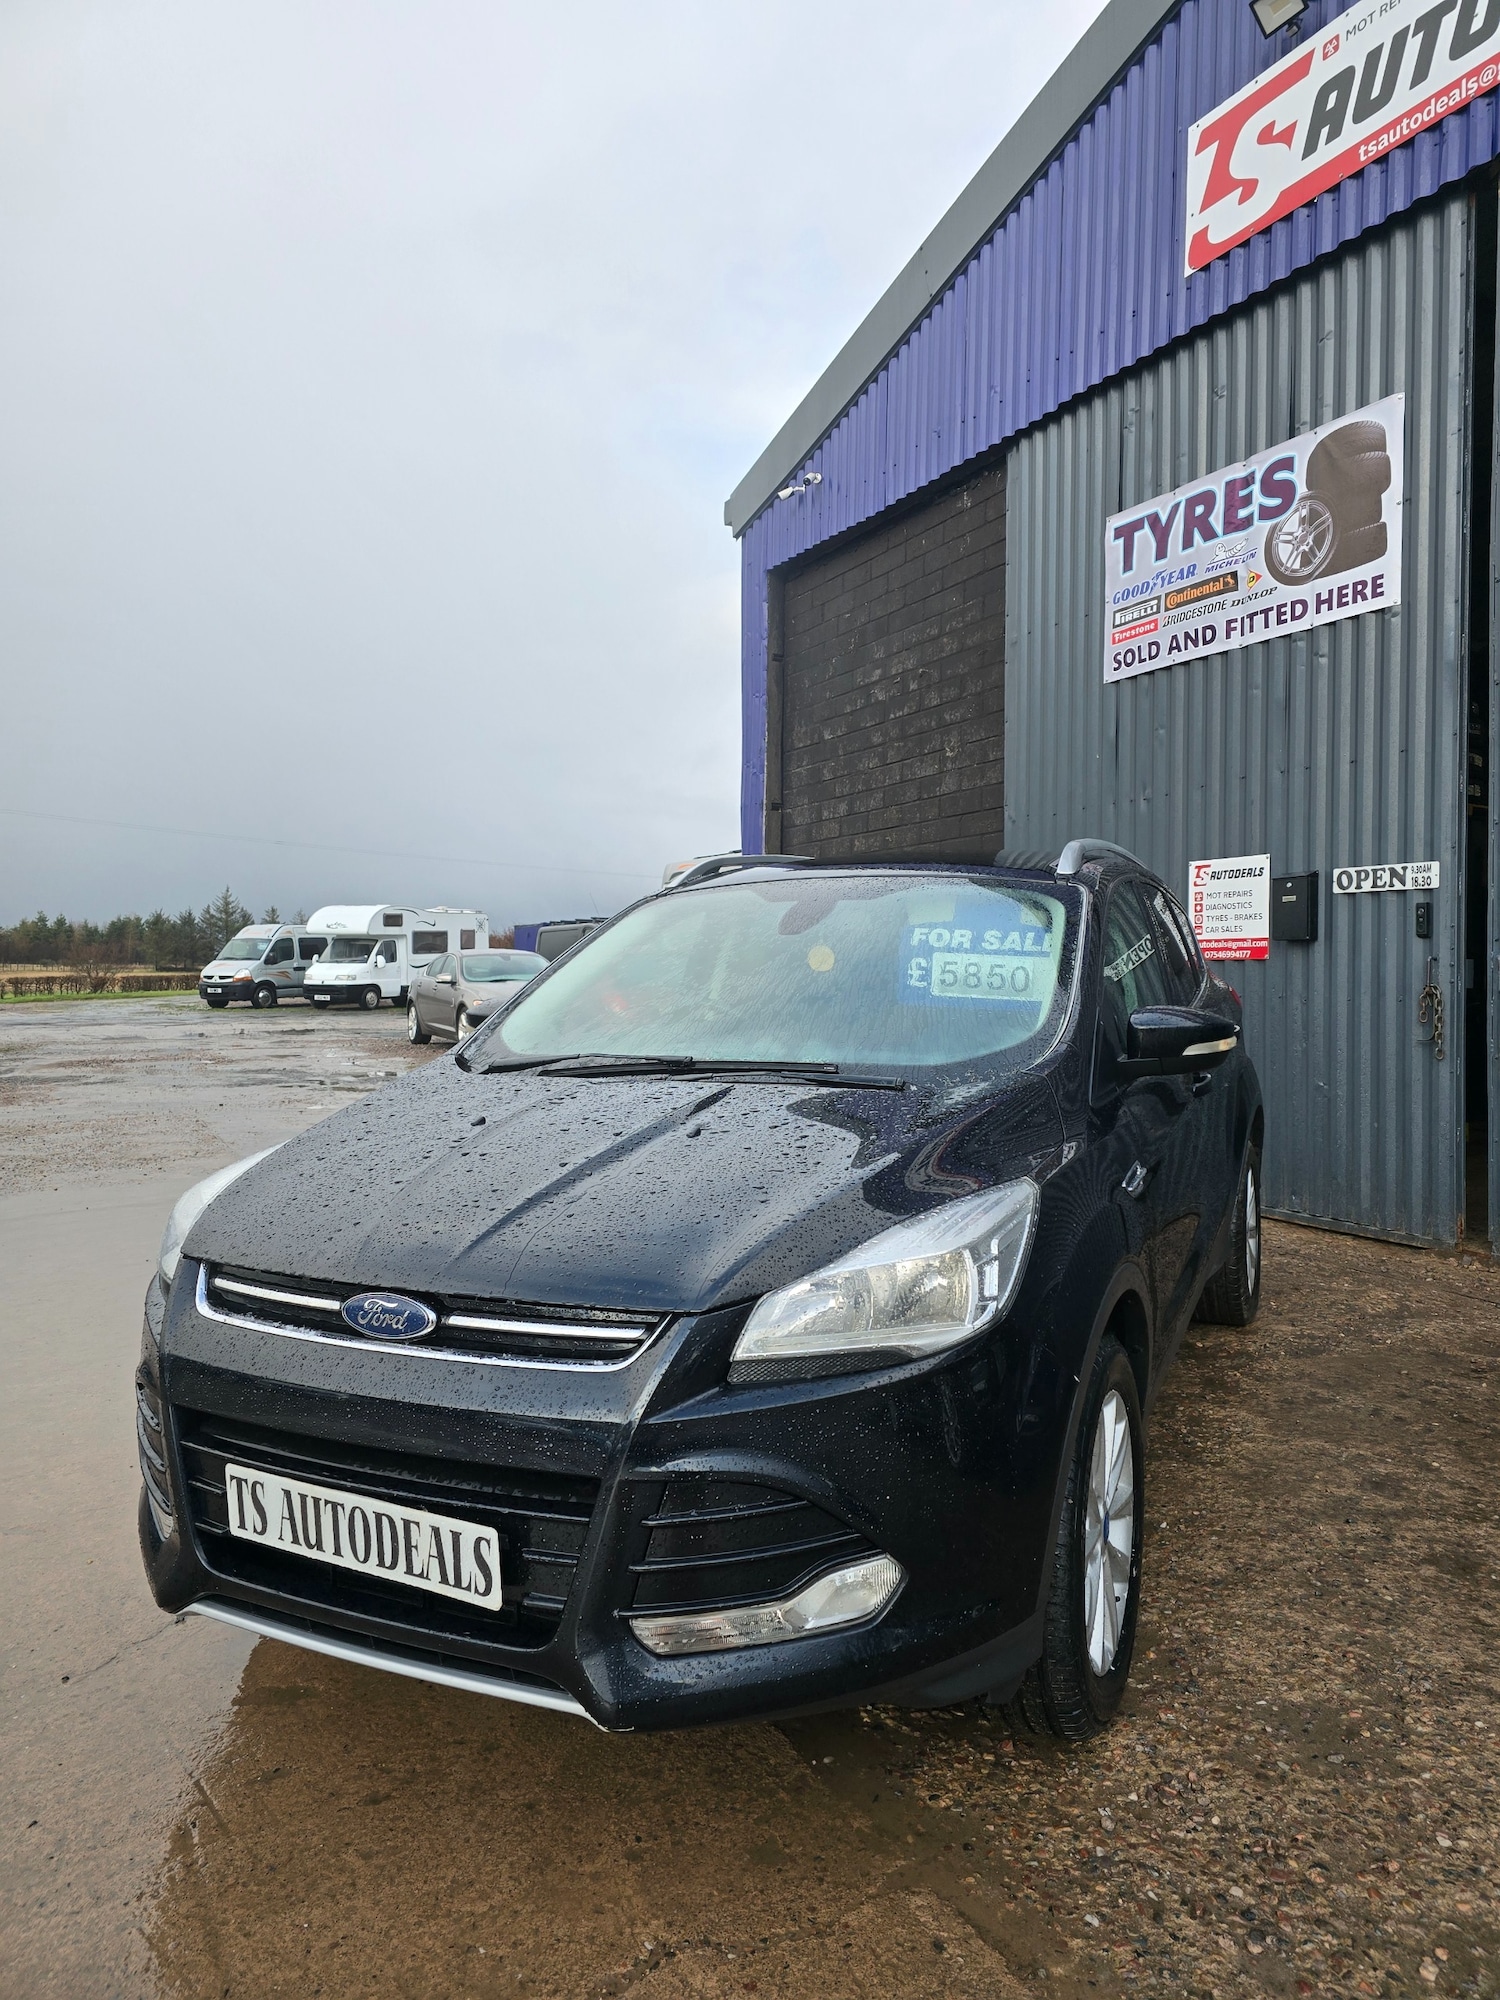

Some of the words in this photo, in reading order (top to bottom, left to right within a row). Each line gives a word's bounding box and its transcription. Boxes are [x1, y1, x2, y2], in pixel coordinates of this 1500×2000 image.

[1345, 10, 1376, 42] MOT
[1379, 0, 1401, 17] RE
[1358, 63, 1500, 162] tsautodeals@
[1113, 455, 1298, 576] TYRES
[1205, 551, 1257, 574] MICHELIN
[1165, 577, 1224, 609] Continental
[1230, 587, 1278, 608] DUNLOP
[1113, 640, 1161, 672] SOLD
[1167, 624, 1217, 656] AND
[1225, 598, 1309, 640] FITTED
[1315, 573, 1385, 615] HERE
[1114, 600, 1158, 626] PIRELLI
[1162, 599, 1227, 628] BRIDGESTONE
[1114, 623, 1156, 643] Firestone
[1210, 867, 1264, 880] AUTODEALS
[1336, 865, 1408, 891] OPEN
[1411, 875, 1432, 888] 18.30
[1205, 901, 1253, 911] DIAGNOSTICS
[1206, 892, 1221, 900] MOT
[1224, 889, 1253, 898] REPAIRS
[1206, 914, 1228, 922] TYRES
[1234, 912, 1263, 921] BRAKES
[910, 927, 973, 949] FOR
[1205, 926, 1219, 934] CAR
[1221, 925, 1243, 933] SALES
[1204, 950, 1251, 959] 07546994177
[357, 1298, 410, 1330] Ford
[229, 1474, 268, 1536] TS
[278, 1487, 493, 1597] AUTODEALS
